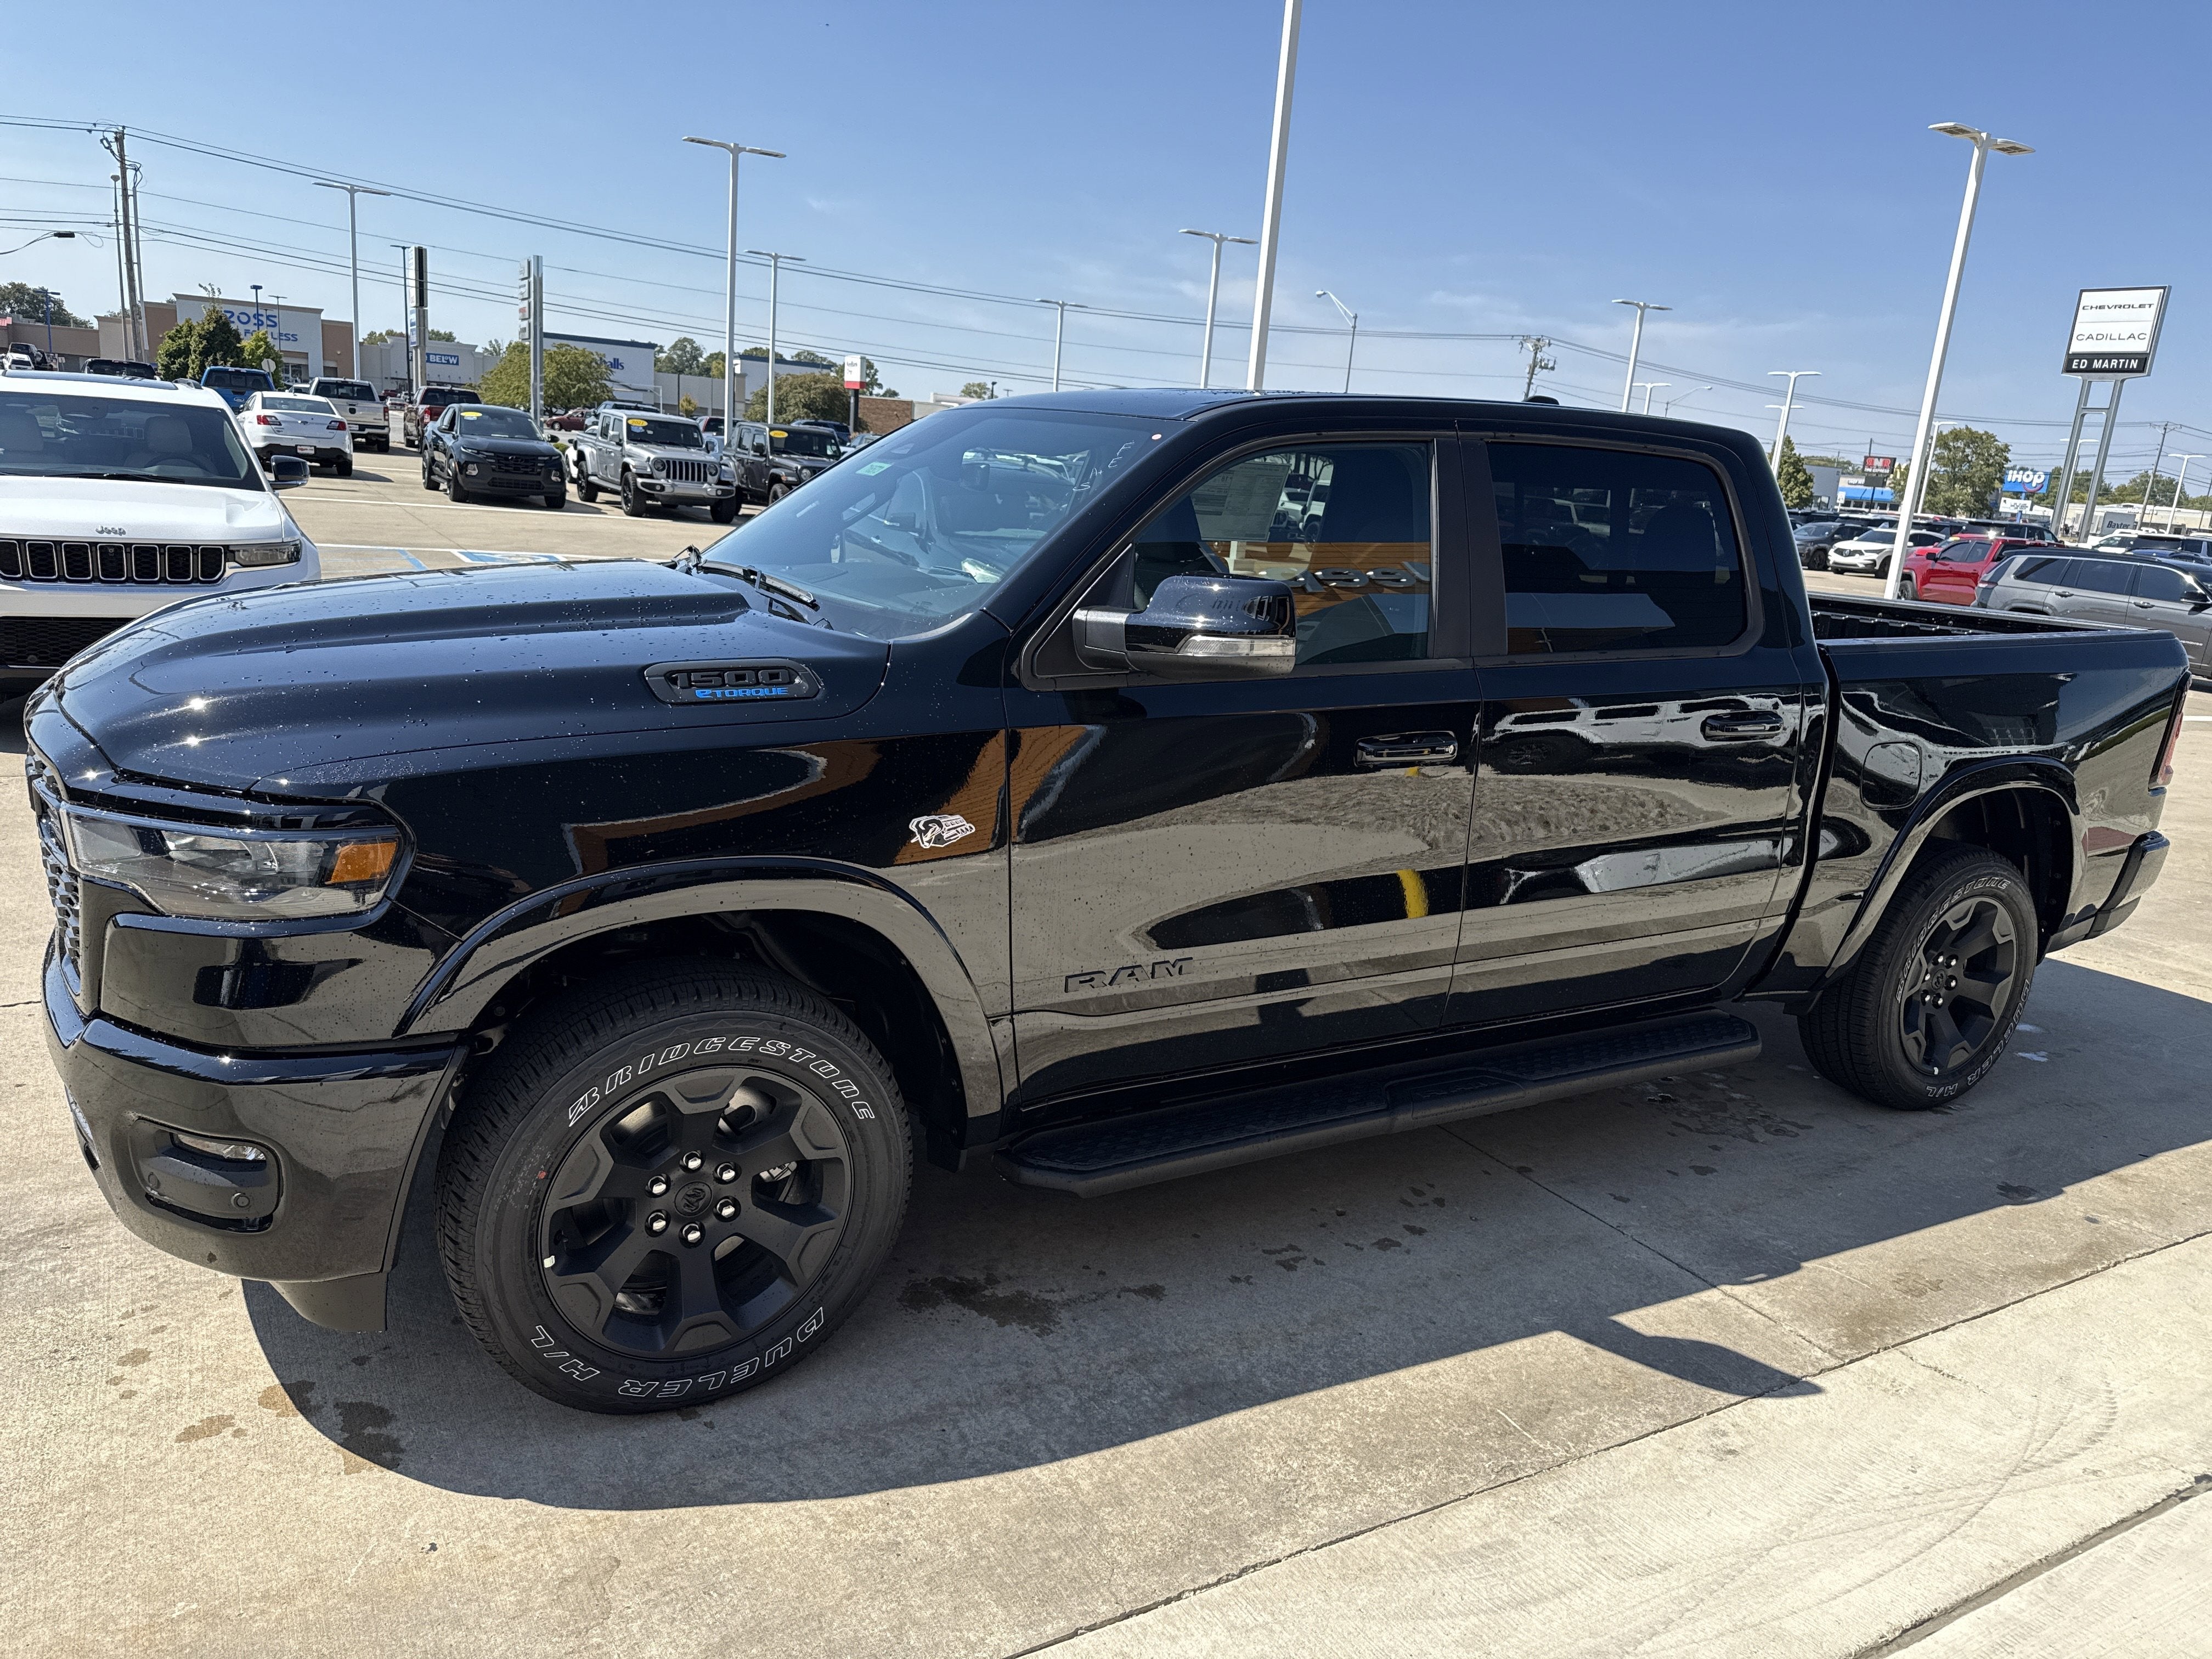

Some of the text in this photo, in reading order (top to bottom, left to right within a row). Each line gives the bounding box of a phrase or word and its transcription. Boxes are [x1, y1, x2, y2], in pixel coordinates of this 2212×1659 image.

[223, 310, 278, 328] ROSS
[271, 331, 298, 342] LESS
[2076, 333, 2147, 341] CADILLAC
[430, 354, 457, 364] BELOW
[2072, 359, 2138, 369] ED MARTIN
[95, 526, 126, 536] Jeep
[2107, 521, 2130, 529] Baxter
[670, 669, 790, 689] 1500
[696, 687, 789, 698] eTORQUE
[1896, 877, 2011, 1004] BRIDGESTONE
[1064, 957, 1193, 993] RAM
[1967, 979, 2031, 1086] DUELER
[568, 1036, 876, 1127] BRIDGESTONE
[1926, 1082, 1959, 1098] H/L
[531, 1325, 601, 1383] H/L
[618, 1307, 825, 1398] DUELER
